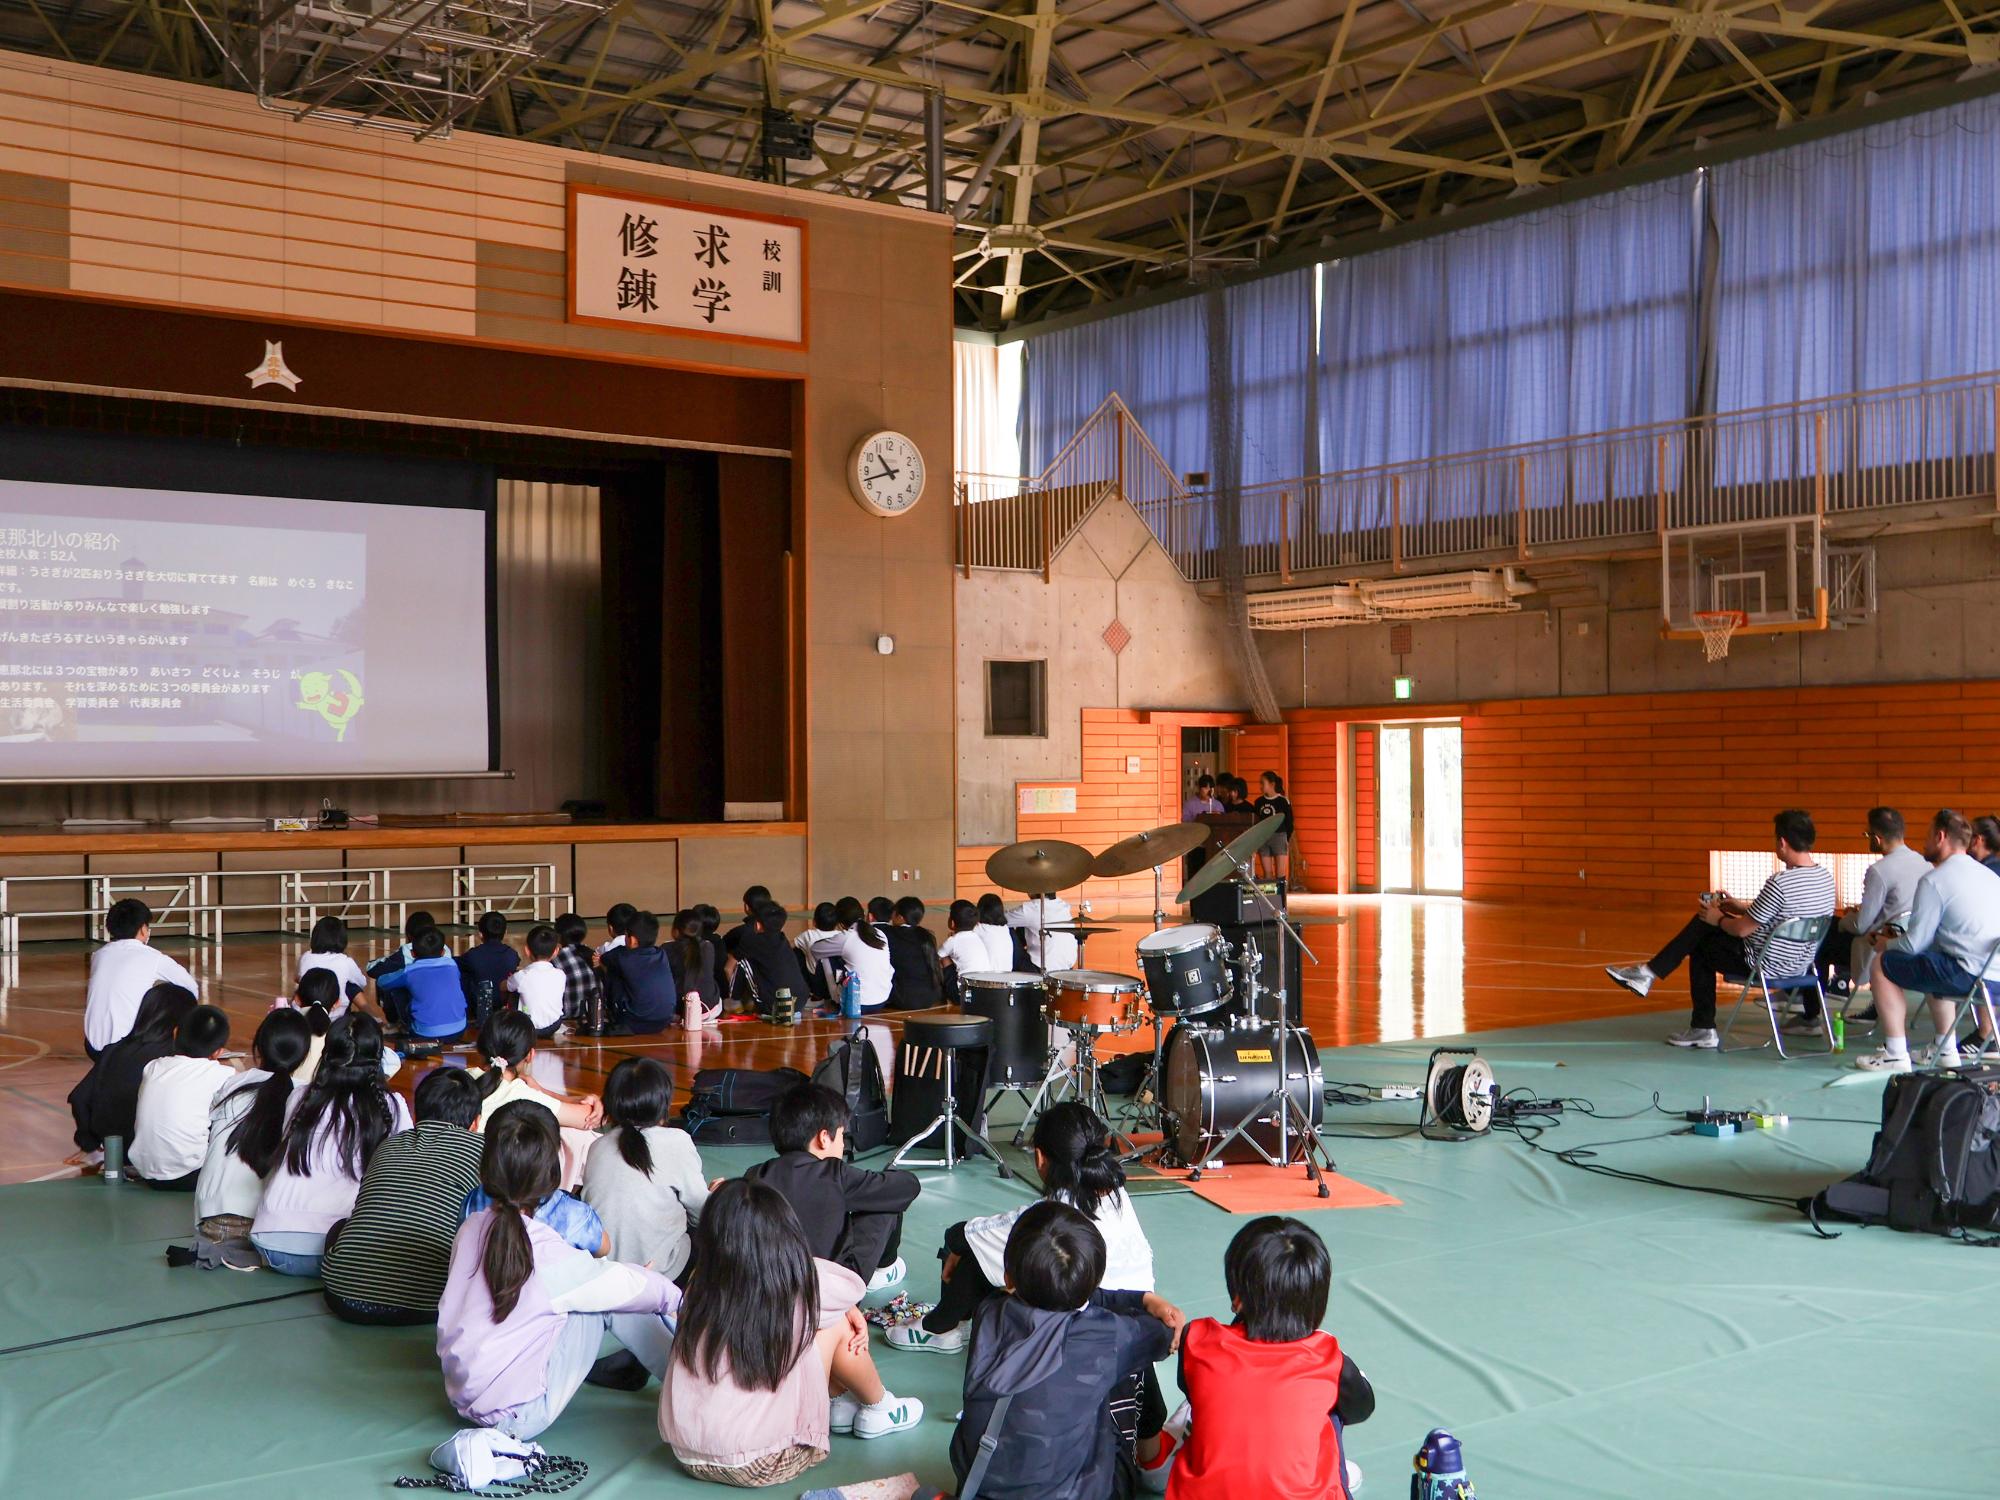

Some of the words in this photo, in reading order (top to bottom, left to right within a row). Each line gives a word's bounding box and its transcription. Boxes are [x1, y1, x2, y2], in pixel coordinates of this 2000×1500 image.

[762, 239, 782, 294] 校訓
[692, 224, 732, 324] 求学
[875, 443, 882, 454] 11
[886, 441, 894, 451] 12
[866, 453, 874, 463] 10
[906, 456, 912, 466] 2
[864, 466, 869, 476] 9
[909, 471, 915, 481] 3
[866, 481, 873, 490] 8
[906, 484, 912, 493] 4
[875, 491, 882, 501] 7
[887, 496, 893, 506] 6
[897, 493, 903, 503] 5
[150, 666, 191, 677] あいさつ
[202, 668, 240, 679] どくしょ
[251, 668, 281, 680] そうじ
